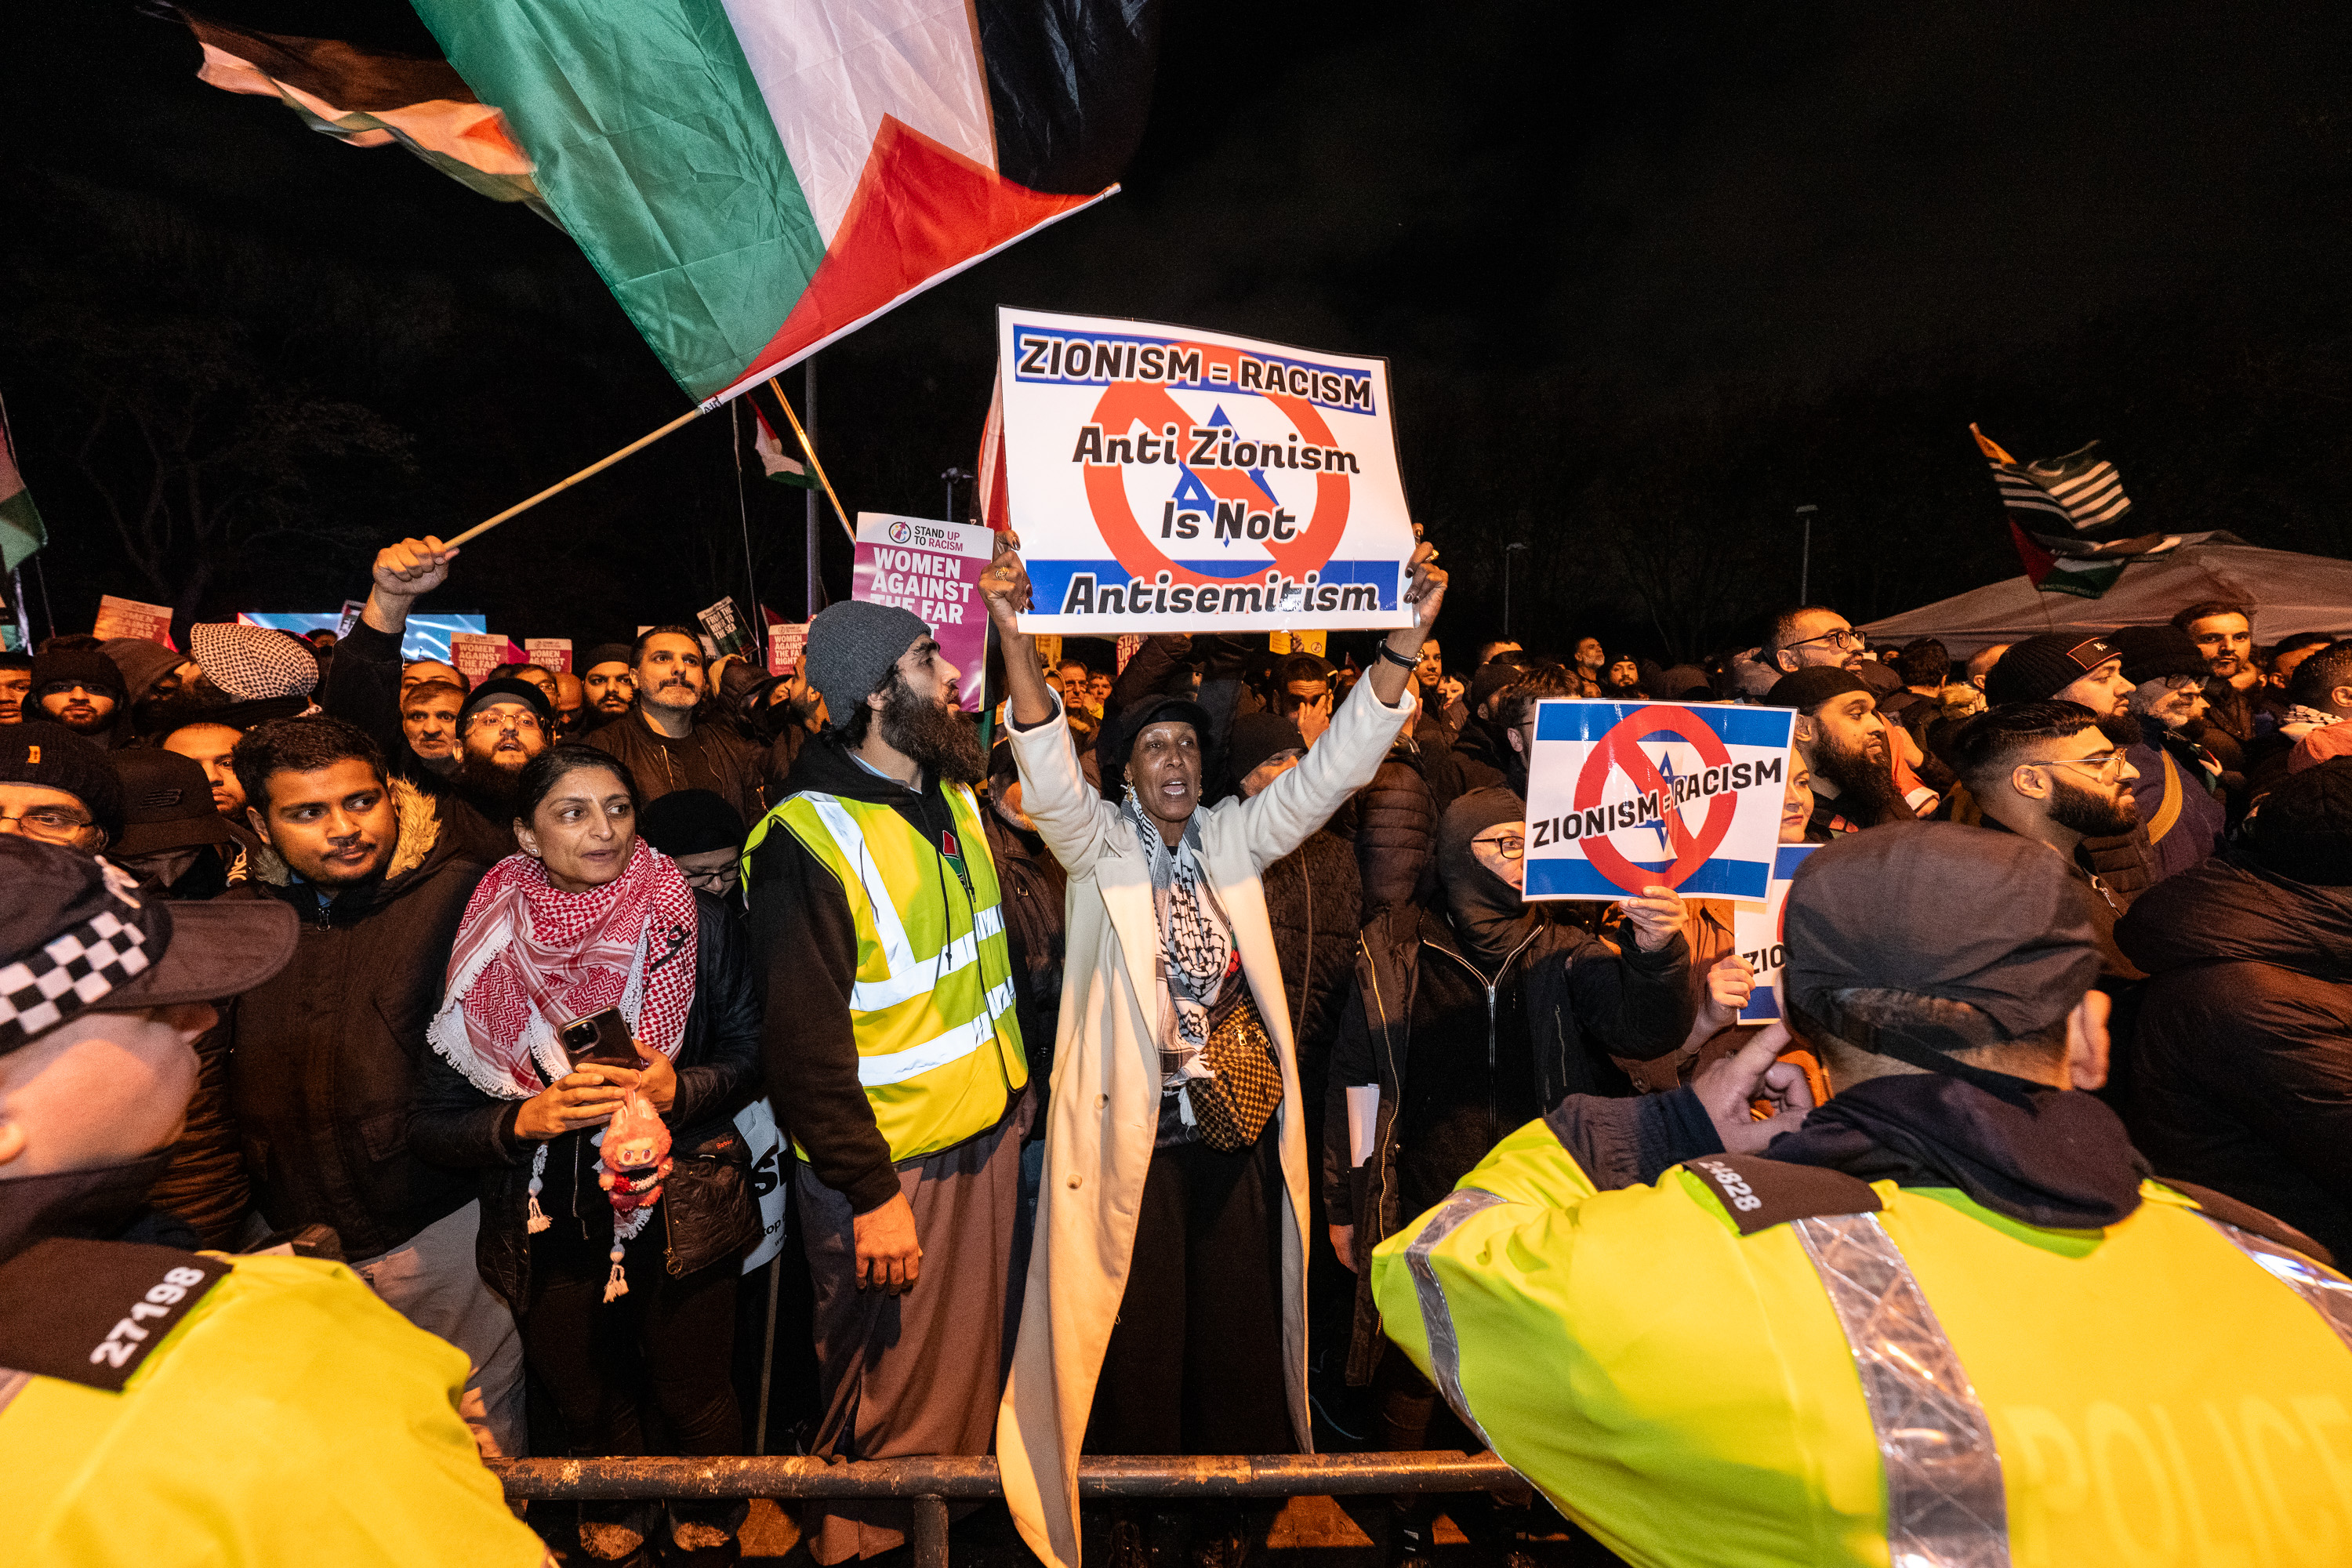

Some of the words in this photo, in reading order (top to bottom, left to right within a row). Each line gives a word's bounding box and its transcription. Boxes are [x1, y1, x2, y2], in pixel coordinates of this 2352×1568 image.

[1020, 337, 1200, 382] ZIONISM
[1212, 365, 1230, 381] =
[1240, 358, 1371, 408] RACISM
[1072, 426, 1178, 465] Anti
[1189, 426, 1360, 474] Zionism
[914, 525, 945, 539] STAND
[947, 530, 960, 541] UP
[1160, 500, 1200, 539] Is
[1214, 501, 1296, 540] Not
[914, 535, 926, 546] TO
[928, 538, 964, 552] RACISM
[873, 546, 961, 579] WOMEN
[870, 571, 974, 603] AGAINST
[920, 599, 964, 625] FAR
[458, 652, 501, 662] AGAINST
[459, 643, 495, 654] WOMEN
[775, 657, 798, 666] RIGHT
[1118, 647, 1131, 662] UP
[478, 661, 498, 670] FAR
[1532, 792, 1659, 849] ZIONISM
[1673, 757, 1782, 807] RACISM
[1741, 943, 1786, 975] ZIO
[89, 1265, 205, 1369] 27198
[1999, 1392, 2352, 1568] POLICE
